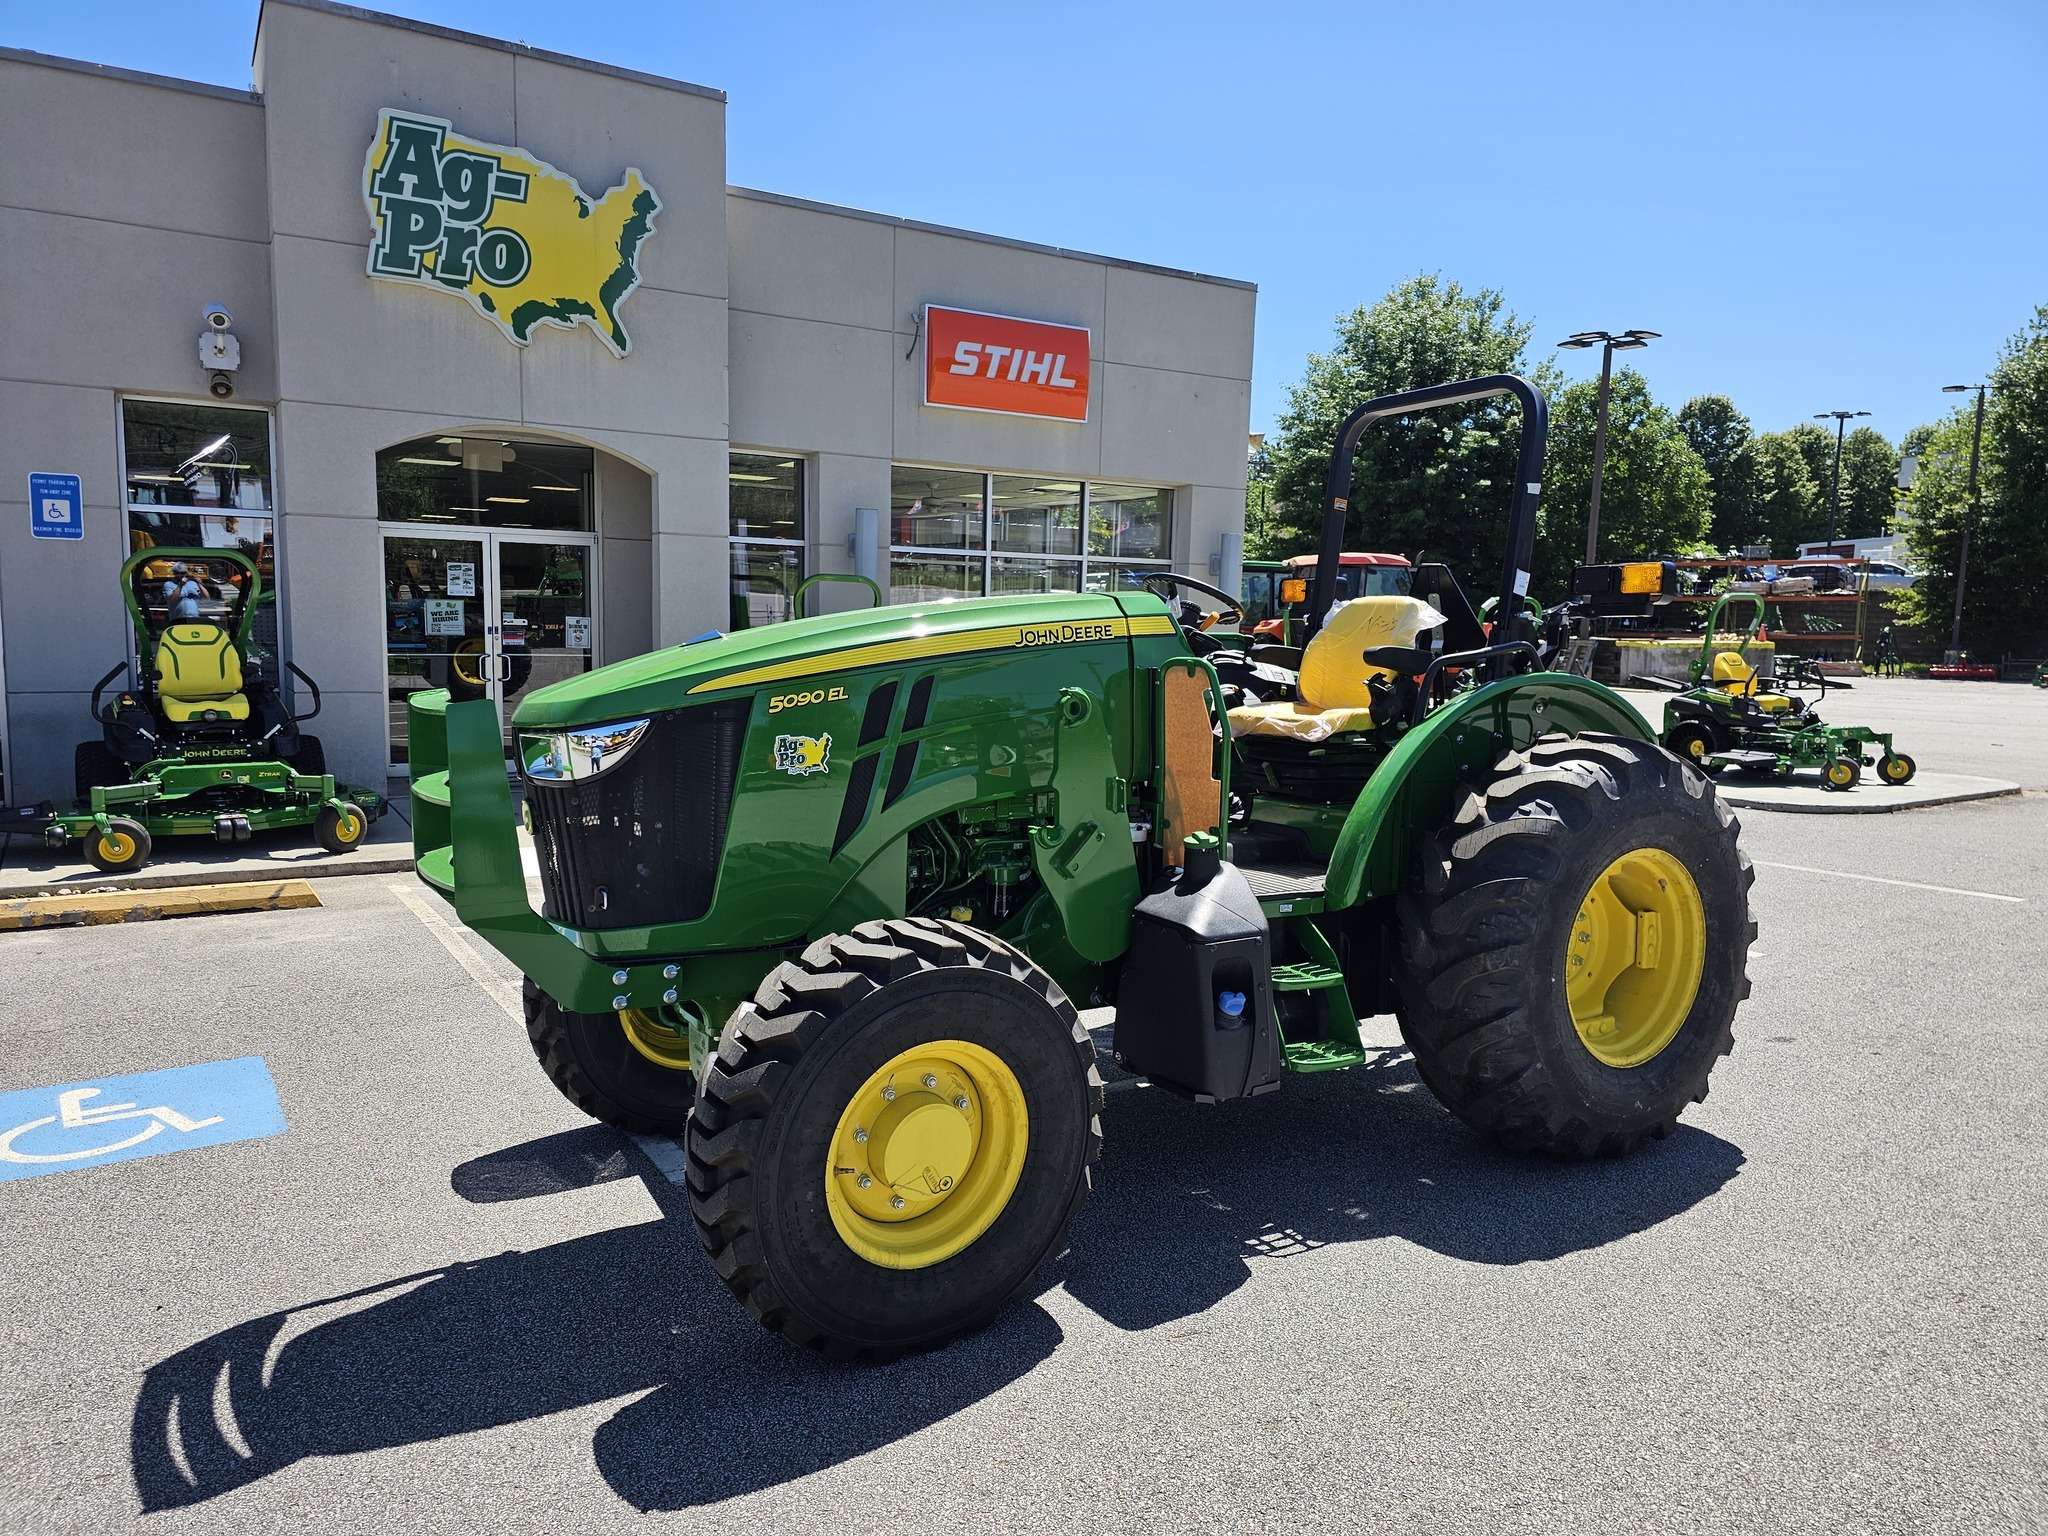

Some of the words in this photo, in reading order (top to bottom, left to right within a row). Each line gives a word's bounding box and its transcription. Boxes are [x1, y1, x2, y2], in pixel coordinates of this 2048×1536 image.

[369, 116, 531, 226] Ag-
[372, 196, 531, 288] Pro
[949, 341, 1077, 389] STIHL
[1015, 628, 1060, 647] JOHN
[1061, 625, 1114, 643] DEERE
[768, 689, 825, 714] 5090
[827, 686, 849, 702] EL
[181, 750, 210, 758] JOHN
[777, 738, 805, 753] Ag-
[778, 752, 806, 767] Pro
